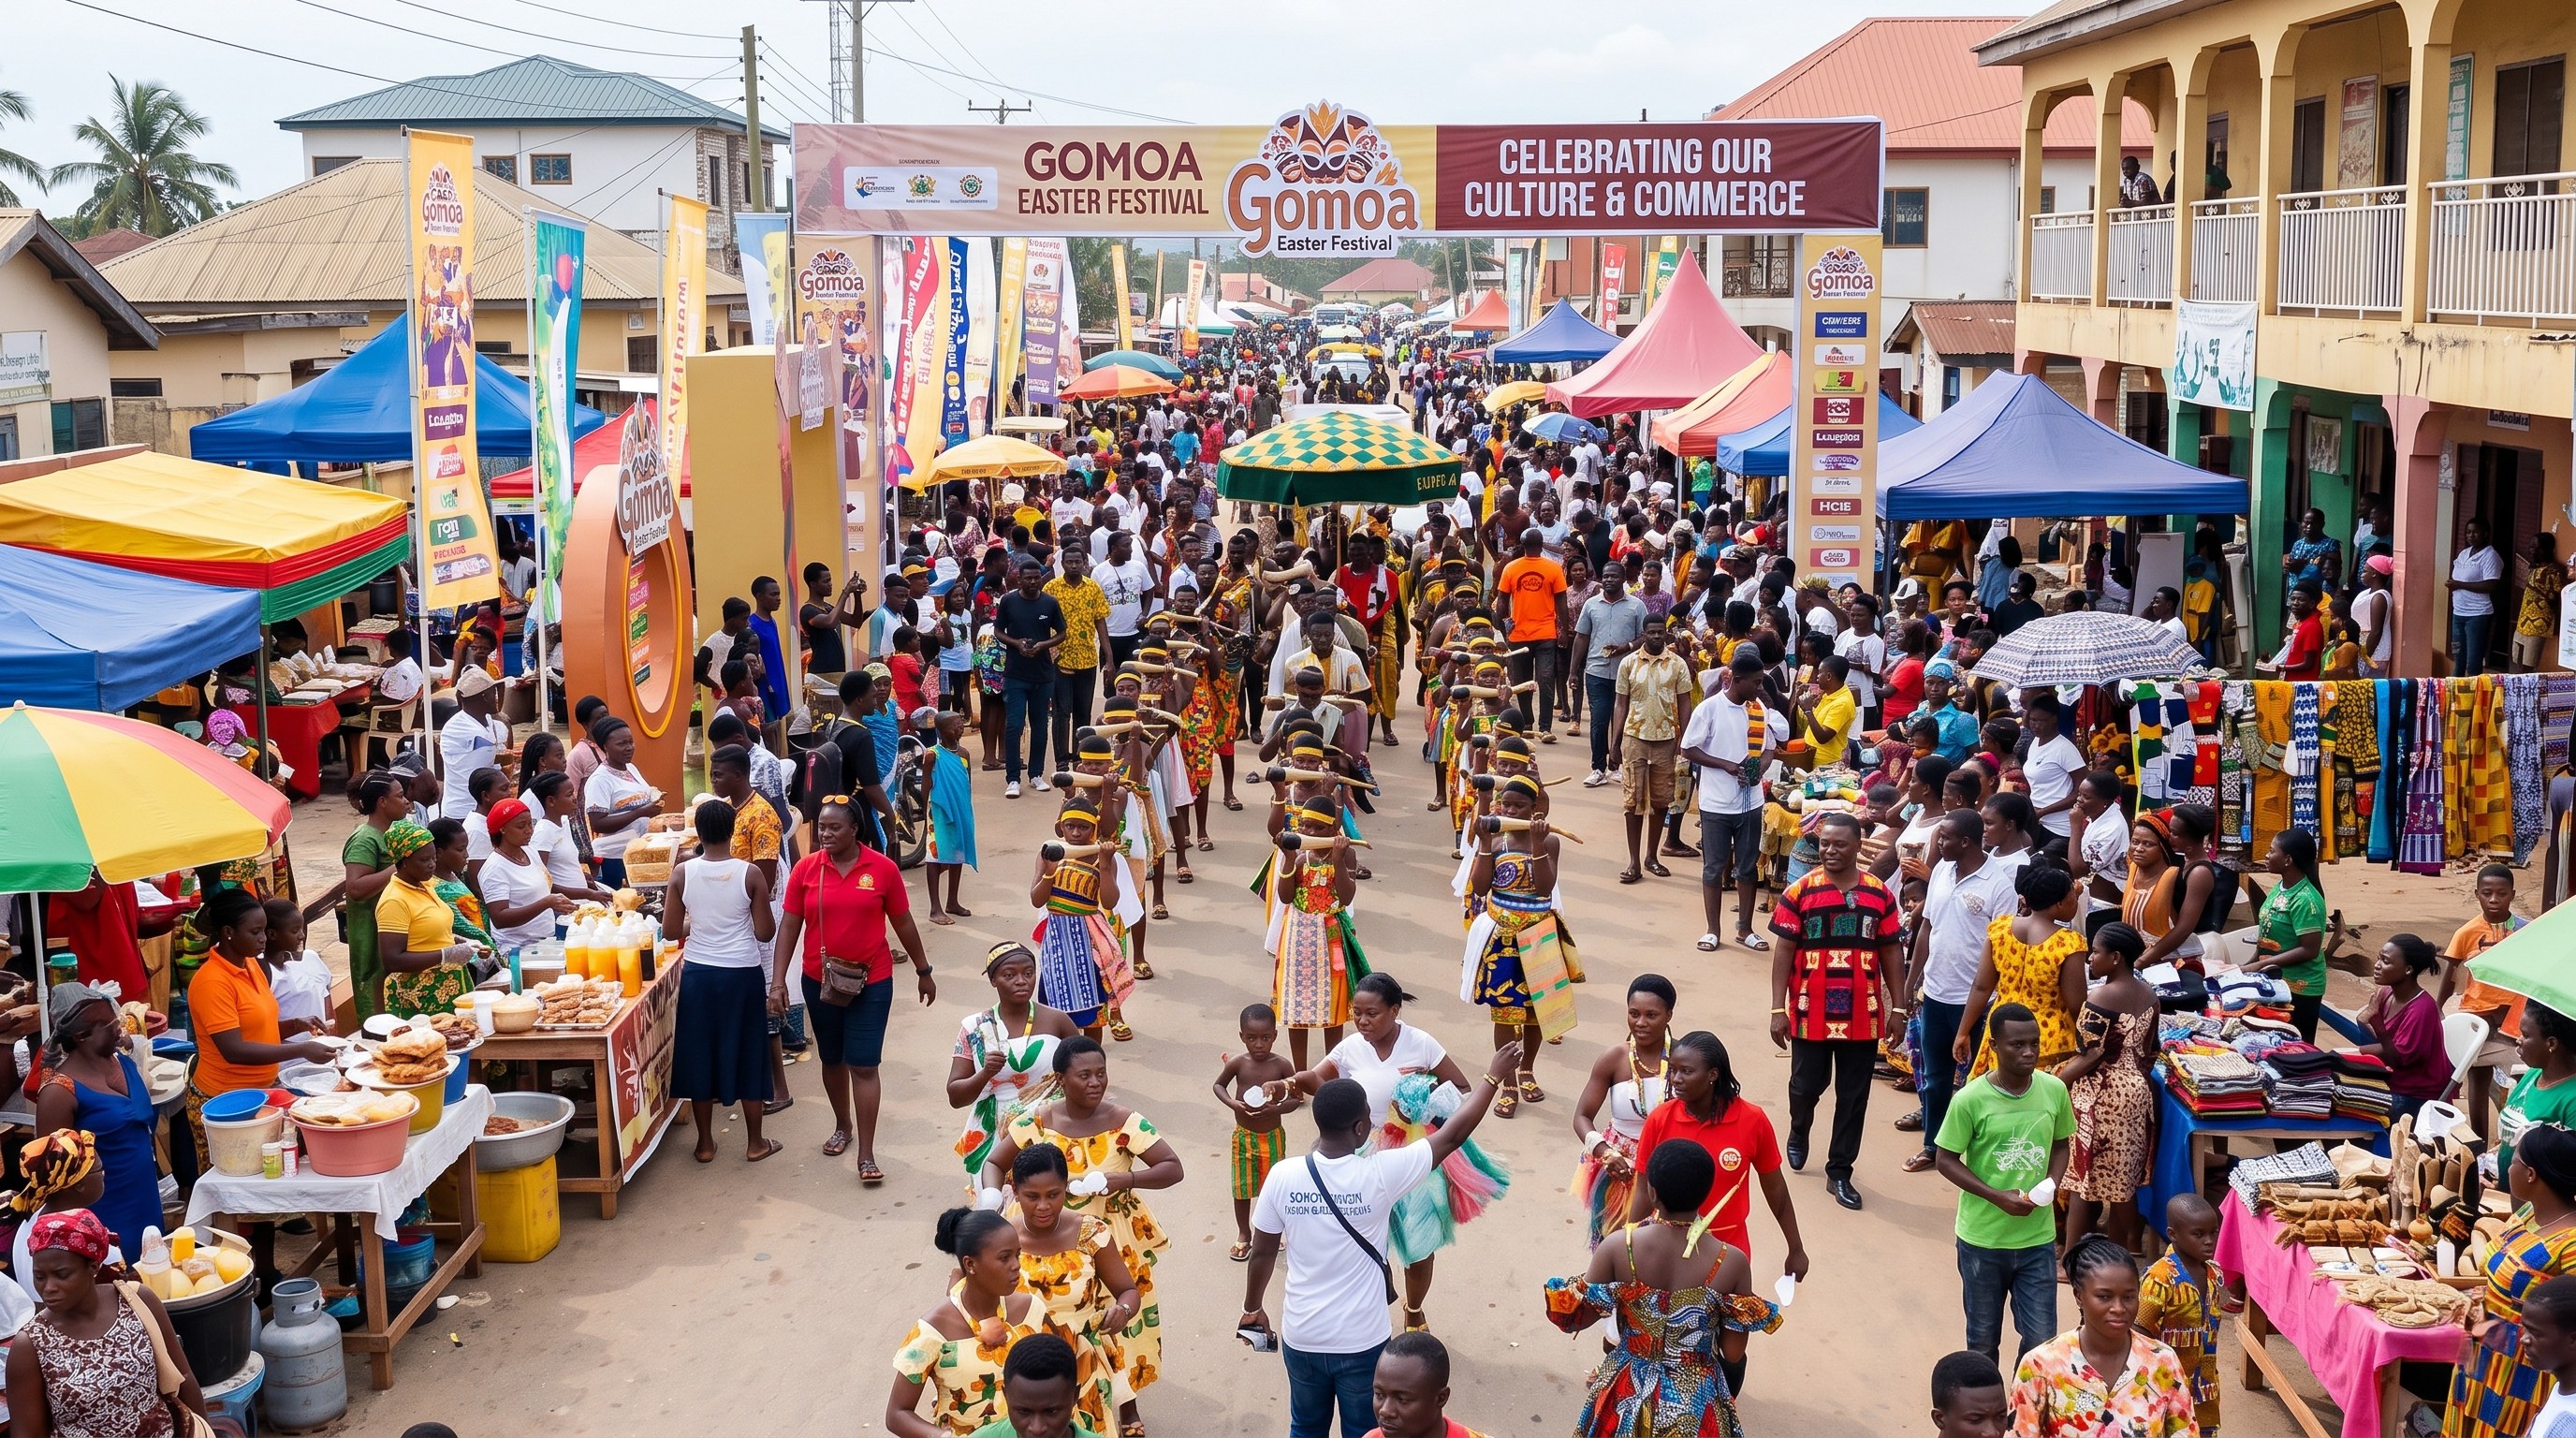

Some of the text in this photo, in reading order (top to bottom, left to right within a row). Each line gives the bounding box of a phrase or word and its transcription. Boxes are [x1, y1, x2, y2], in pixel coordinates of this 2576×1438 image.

[1024, 141, 1203, 181] GOMOA
[1500, 138, 1772, 175] CELEBRATING OUR
[422, 193, 463, 232] Gomoa
[1018, 188, 1209, 215] EASTER FESTIVAL
[1228, 163, 1418, 252] Gomoa
[1465, 180, 1806, 218] CULTURE & COMMERCE
[1277, 235, 1392, 252] Easter Festival
[799, 270, 865, 300] Gomoa
[1808, 269, 1873, 299] Gomoa
[619, 469, 671, 554] Gomoa
